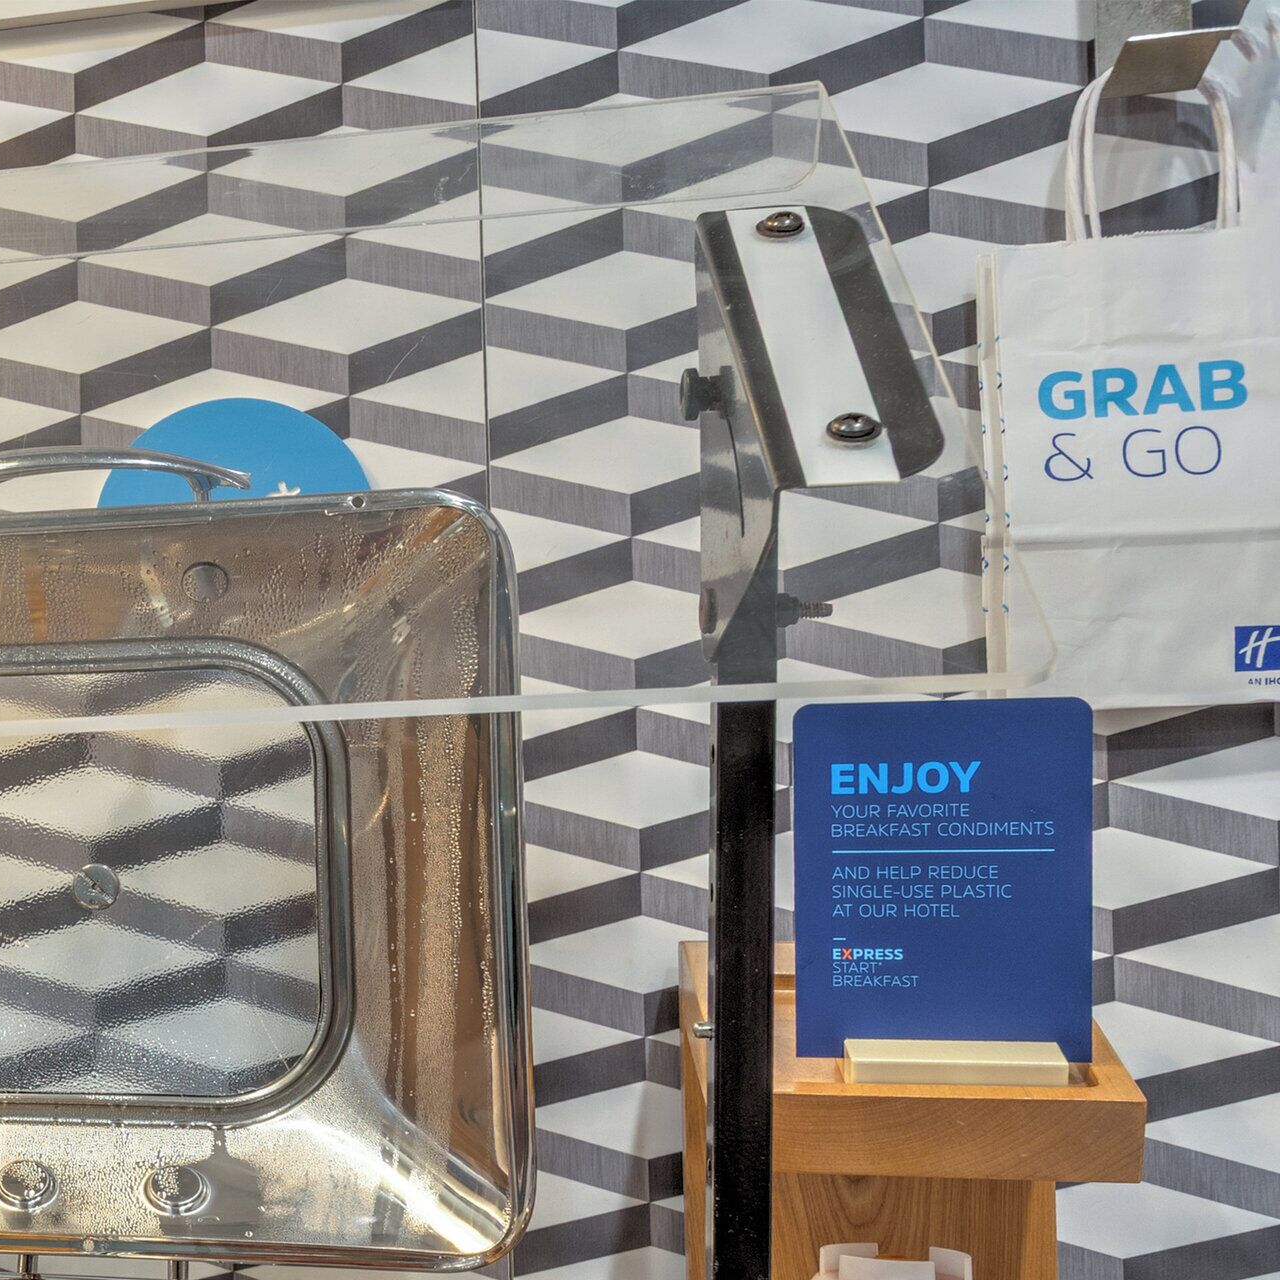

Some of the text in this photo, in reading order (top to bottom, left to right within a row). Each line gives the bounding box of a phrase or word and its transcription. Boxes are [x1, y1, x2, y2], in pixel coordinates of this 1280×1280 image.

[1037, 359, 1248, 420] GRAB
[1043, 425, 1222, 482] & GO
[831, 760, 982, 795] ENJOY
[830, 803, 970, 819] YOUR FAVORITE
[830, 820, 1055, 838] BREAKFAST CONDIMENTS
[831, 864, 999, 880] AND HELP REDUCE
[831, 883, 1012, 899] SINGLE-USE PLASTIC
[832, 903, 960, 918] AT OUR HOTEL
[832, 947, 904, 961] EXPRESS
[832, 975, 919, 988] BREAKFAST
